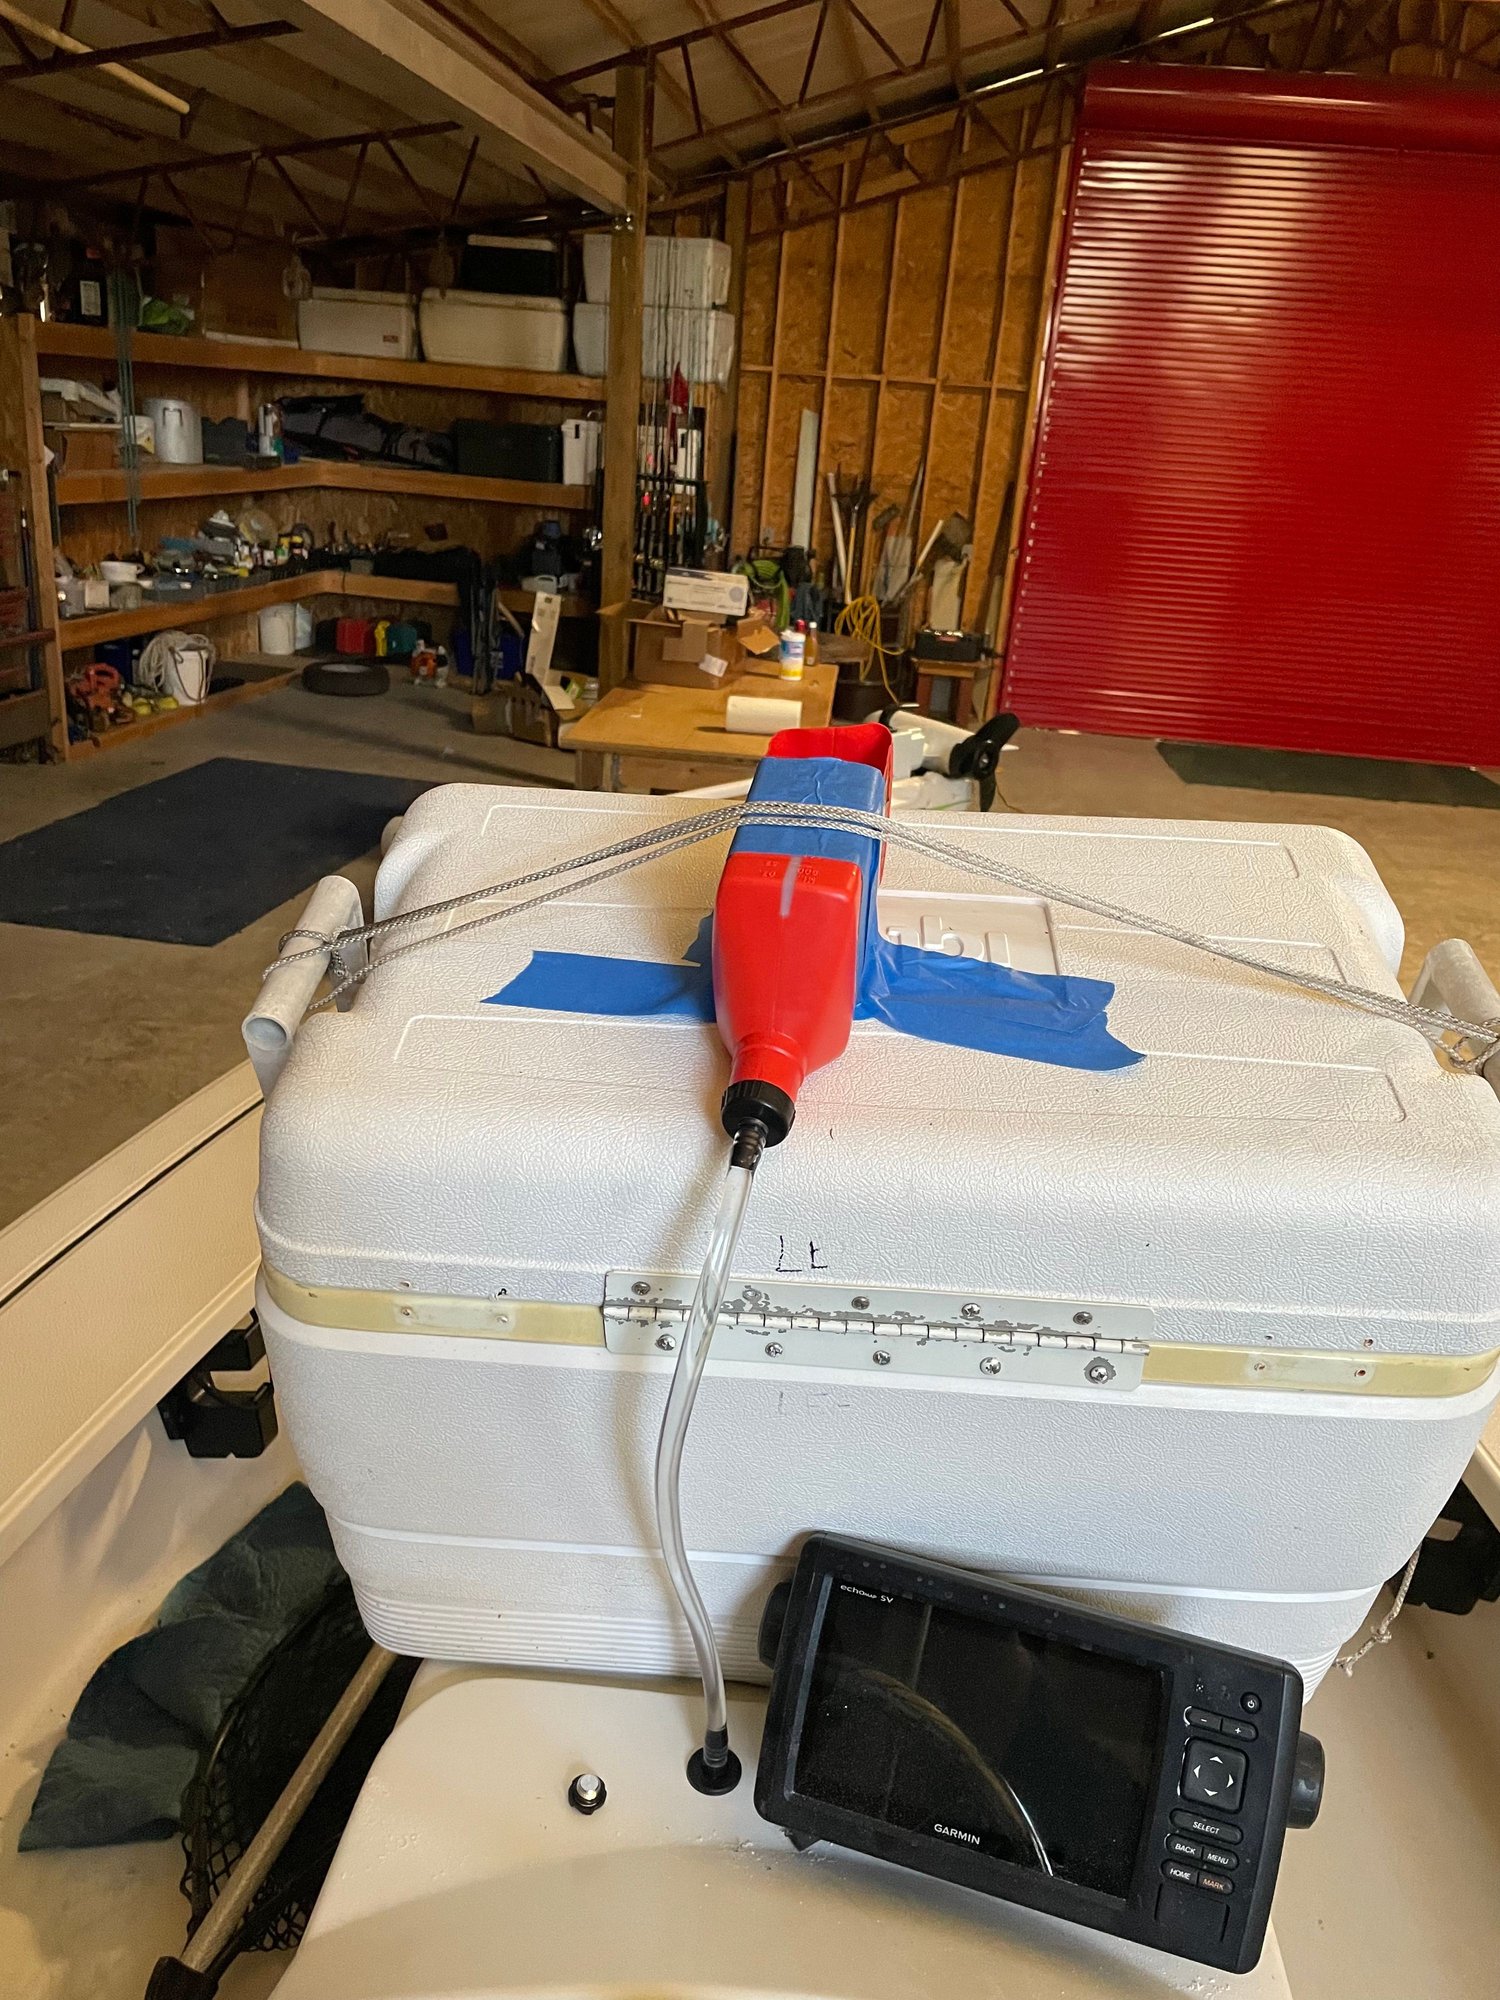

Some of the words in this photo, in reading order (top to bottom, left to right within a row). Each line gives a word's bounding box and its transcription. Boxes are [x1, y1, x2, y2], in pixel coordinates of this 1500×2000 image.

[880, 1594, 894, 1603] SV
[1192, 1821, 1220, 1834] SELECT
[934, 1823, 981, 1845] GARMIN
[1175, 1843, 1196, 1855] BACK
[1207, 1853, 1229, 1865] MENU
[1169, 1868, 1191, 1880] HOME
[1203, 1878, 1224, 1890] MARK
